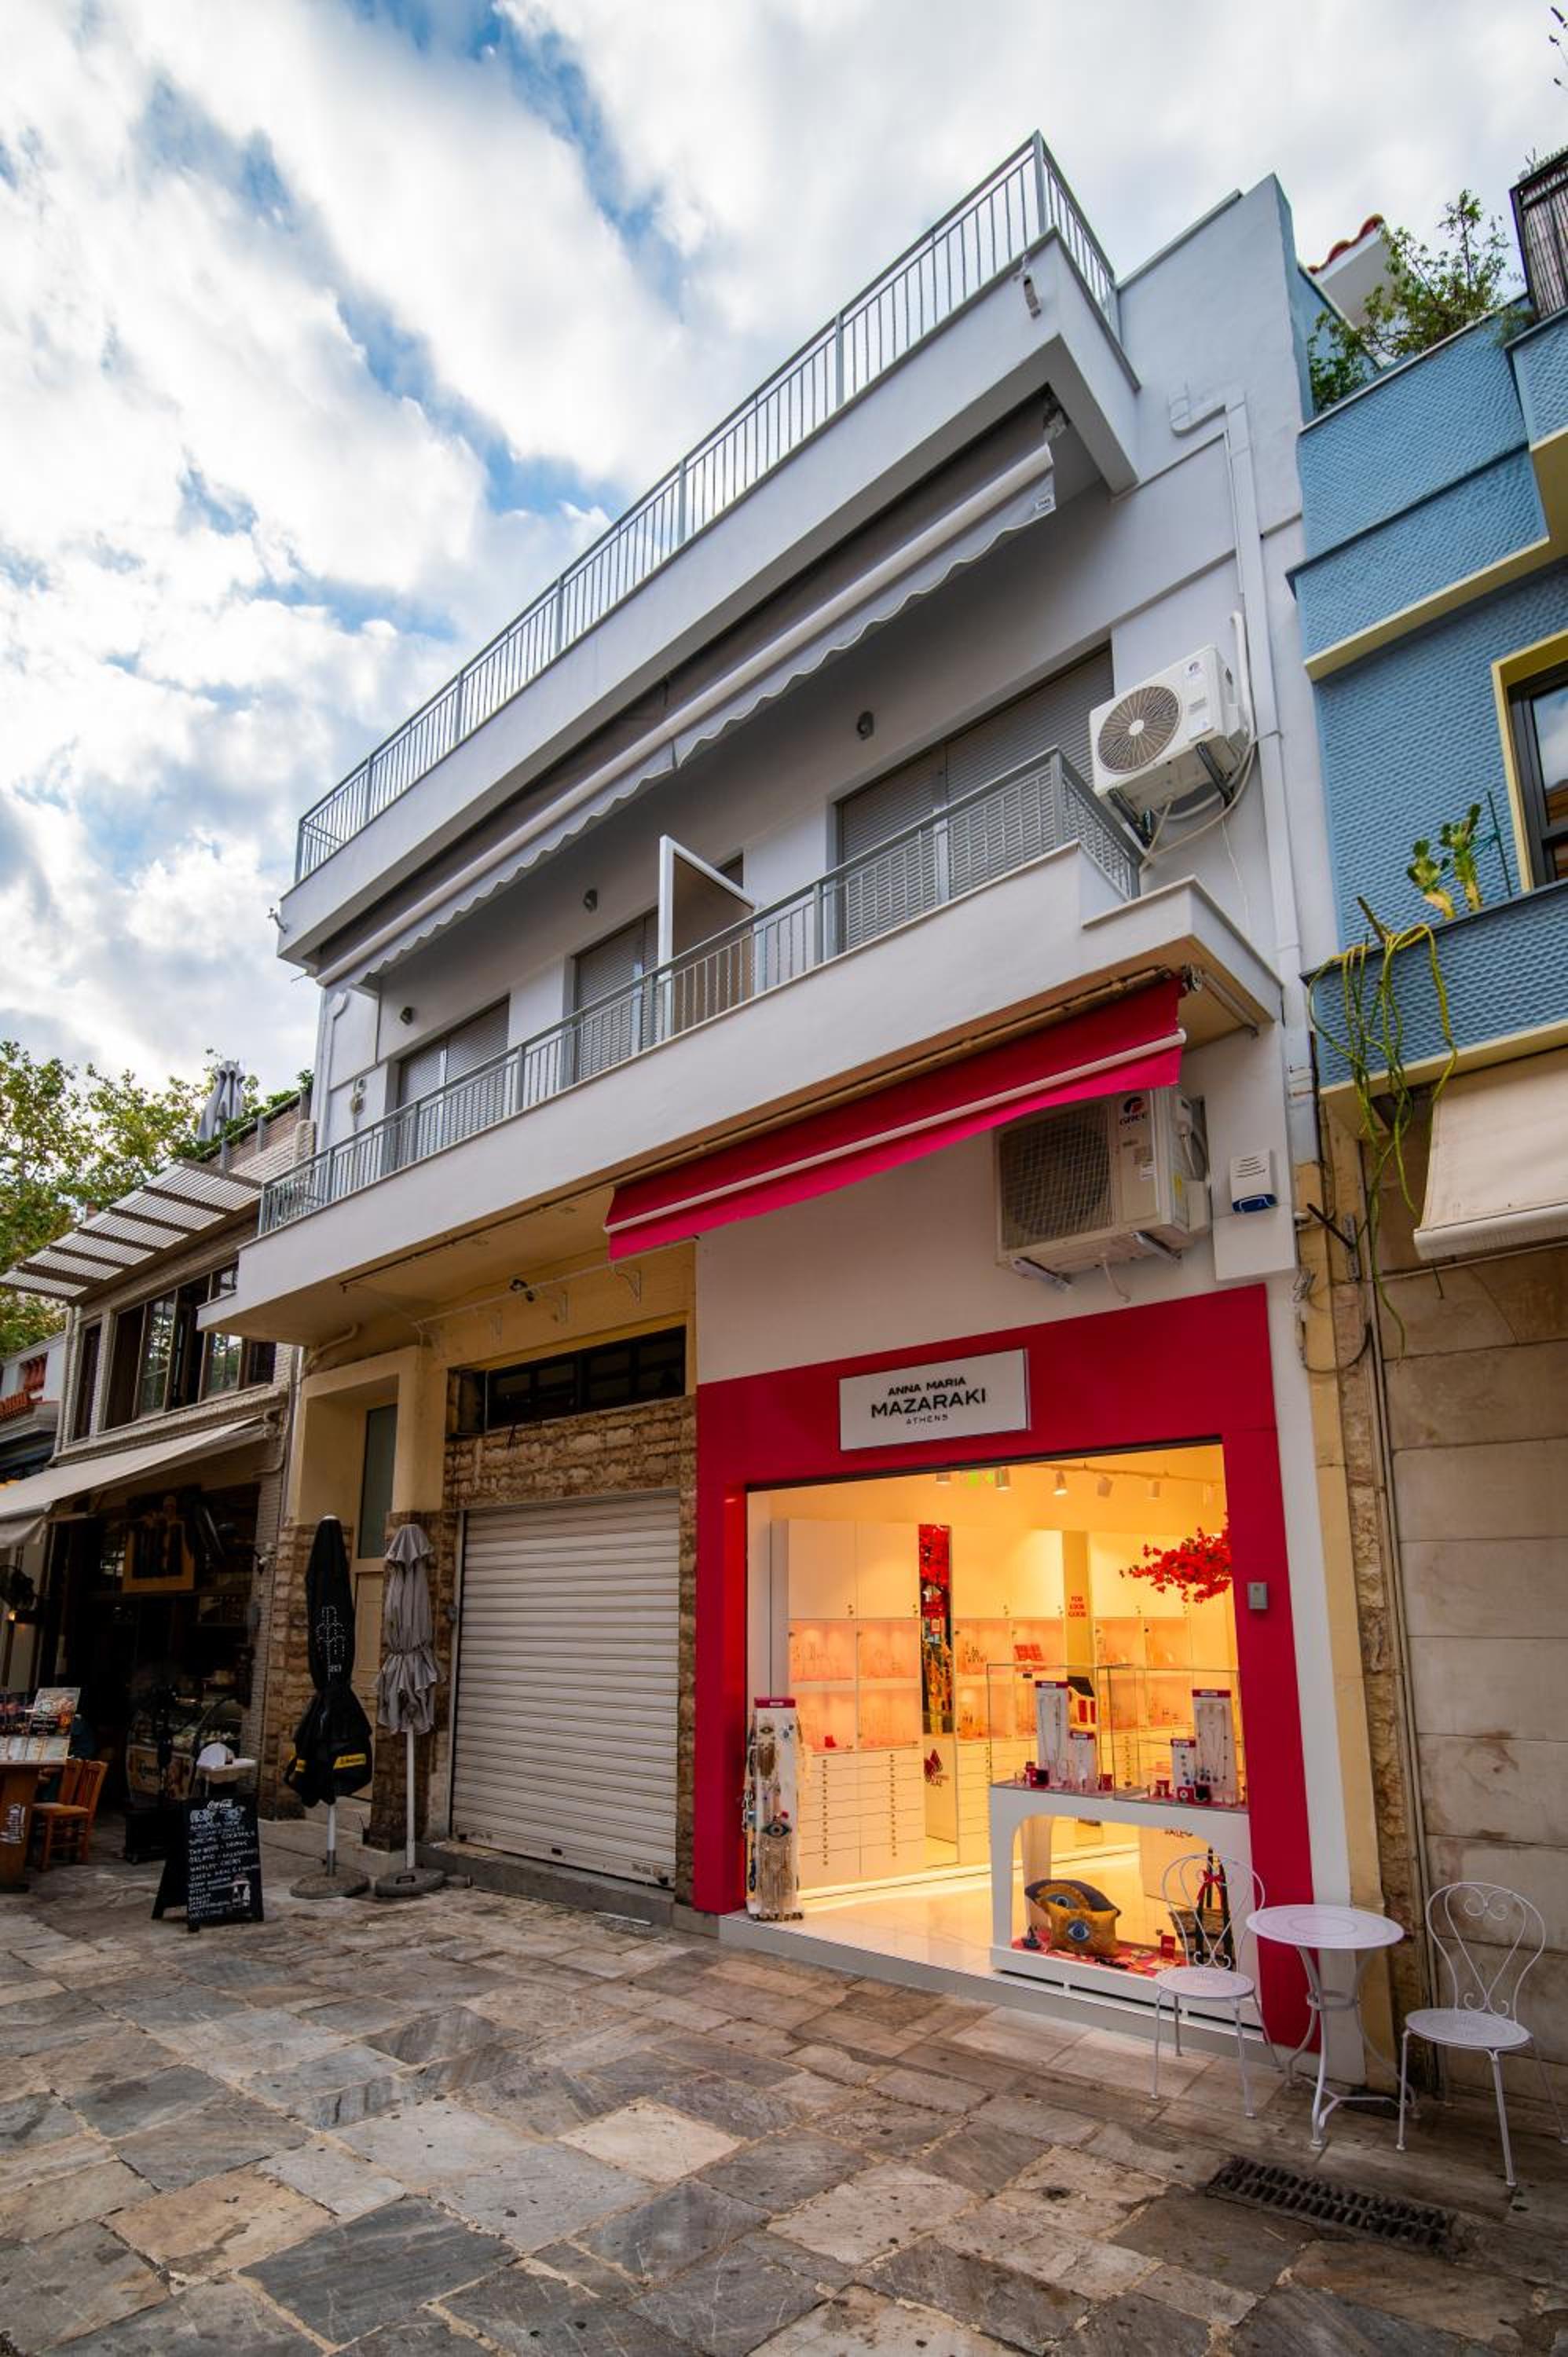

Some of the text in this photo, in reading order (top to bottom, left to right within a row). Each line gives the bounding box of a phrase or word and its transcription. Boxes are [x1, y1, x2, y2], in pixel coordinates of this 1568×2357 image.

[888, 1376, 967, 1396] ANNA MARIA
[870, 1387, 987, 1418] MAZARAKI
[906, 1414, 949, 1425] ATHENS
